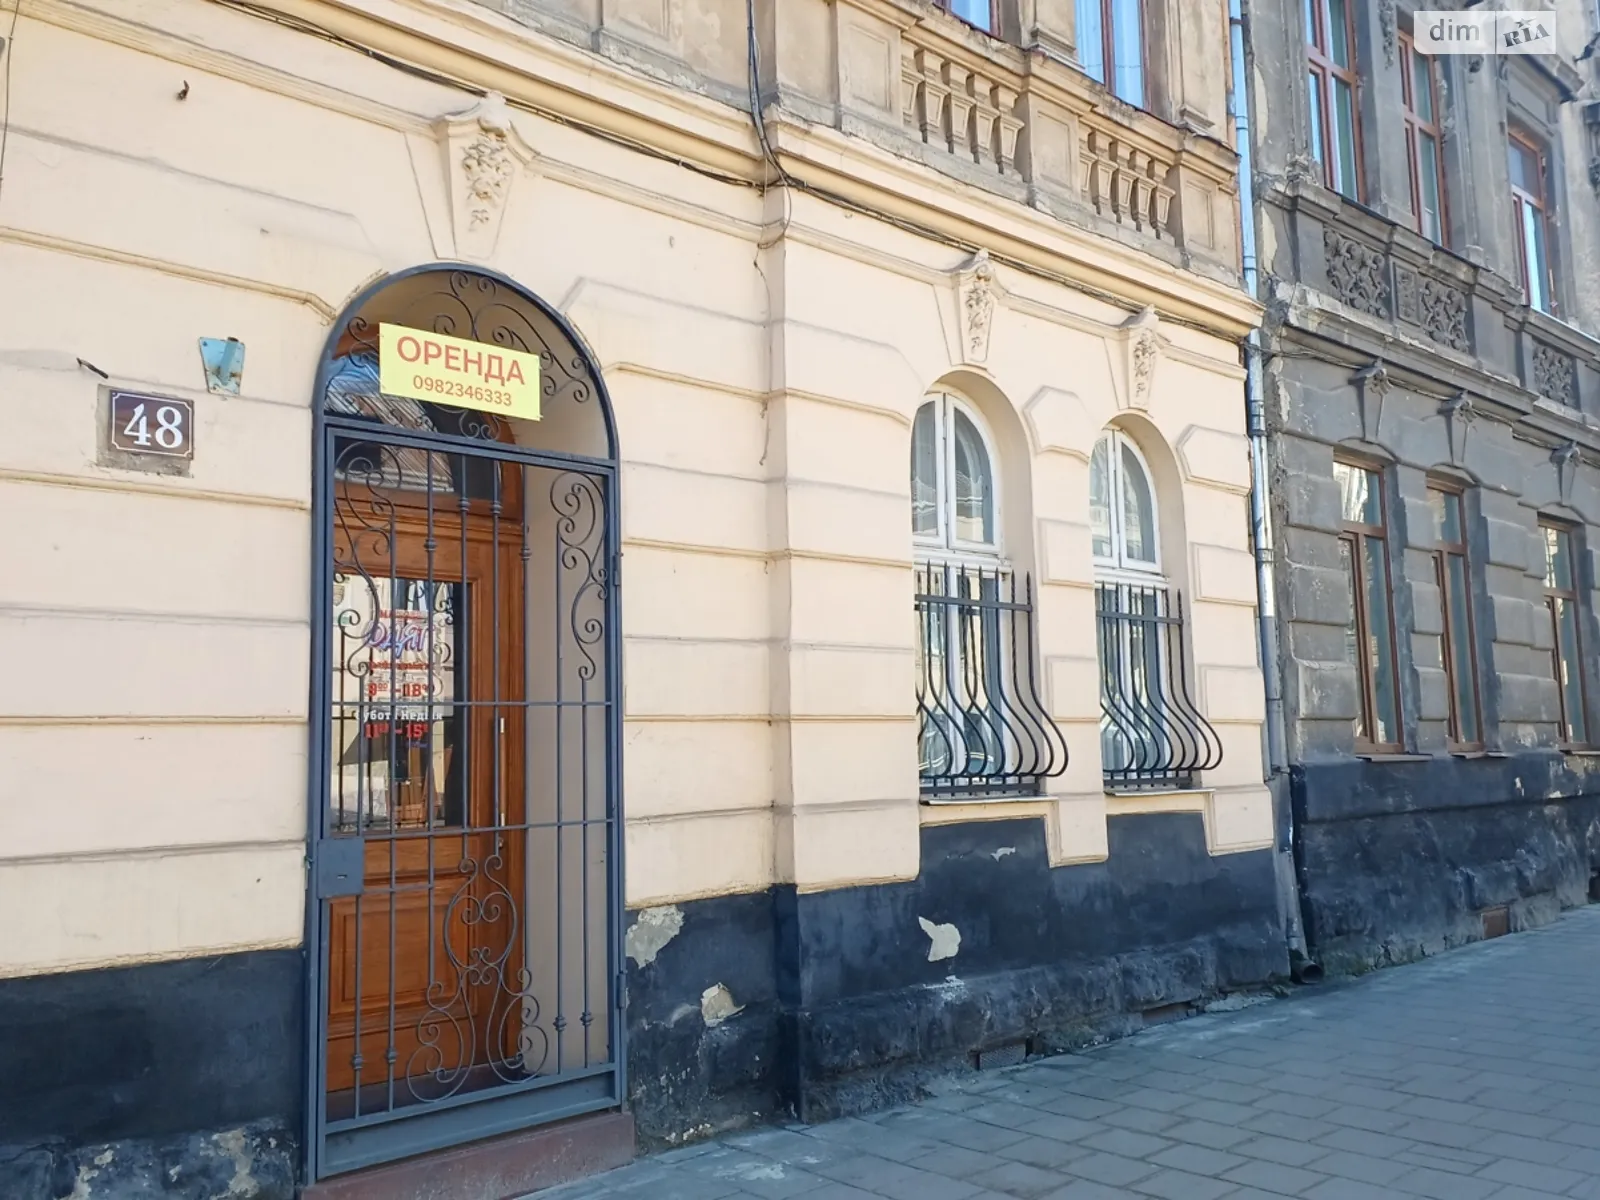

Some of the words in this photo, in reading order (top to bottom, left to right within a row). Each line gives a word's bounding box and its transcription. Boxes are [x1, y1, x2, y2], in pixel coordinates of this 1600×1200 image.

[396, 335, 526, 387] ОРЕНДА
[412, 374, 513, 407] 0982346333
[123, 402, 183, 449] 48
